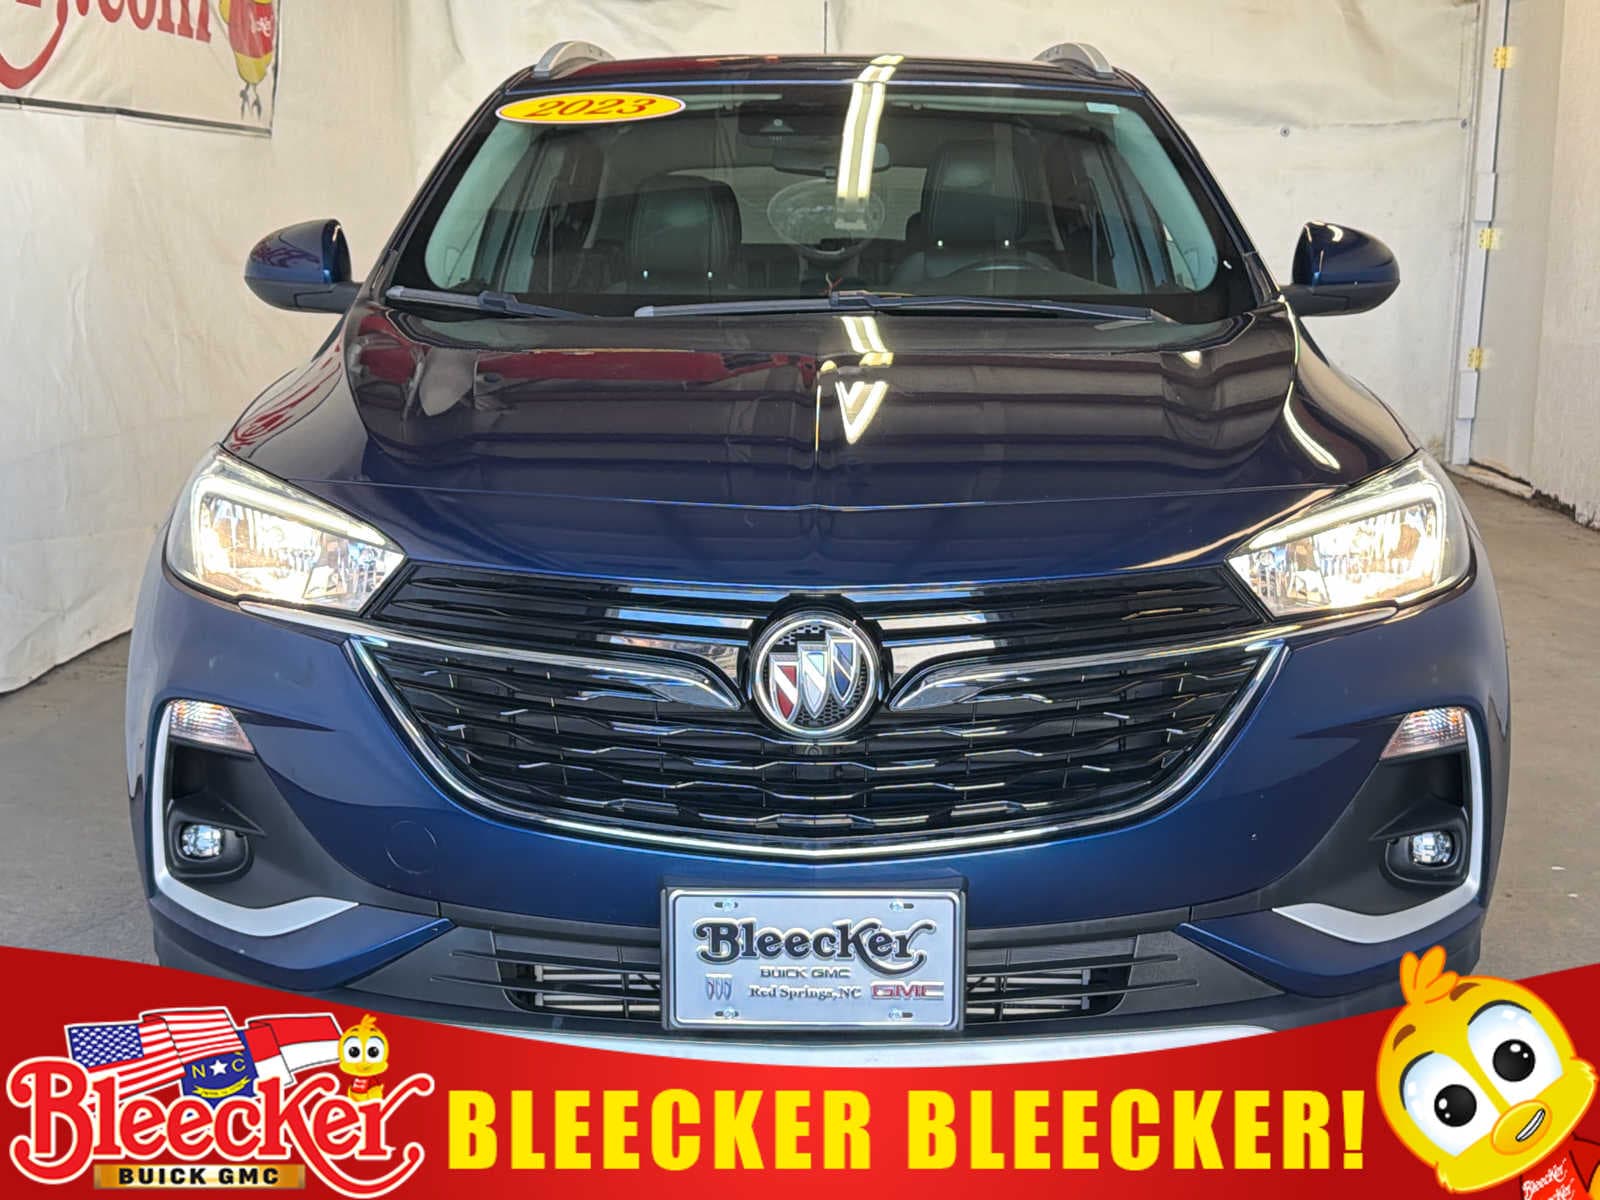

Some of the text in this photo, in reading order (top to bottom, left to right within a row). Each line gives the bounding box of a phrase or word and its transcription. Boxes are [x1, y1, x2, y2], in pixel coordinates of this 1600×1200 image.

[524, 98, 657, 117] 2023
[760, 967, 851, 978] BUICK GMC
[750, 986, 779, 999] Red
[871, 981, 944, 1000] GMC
